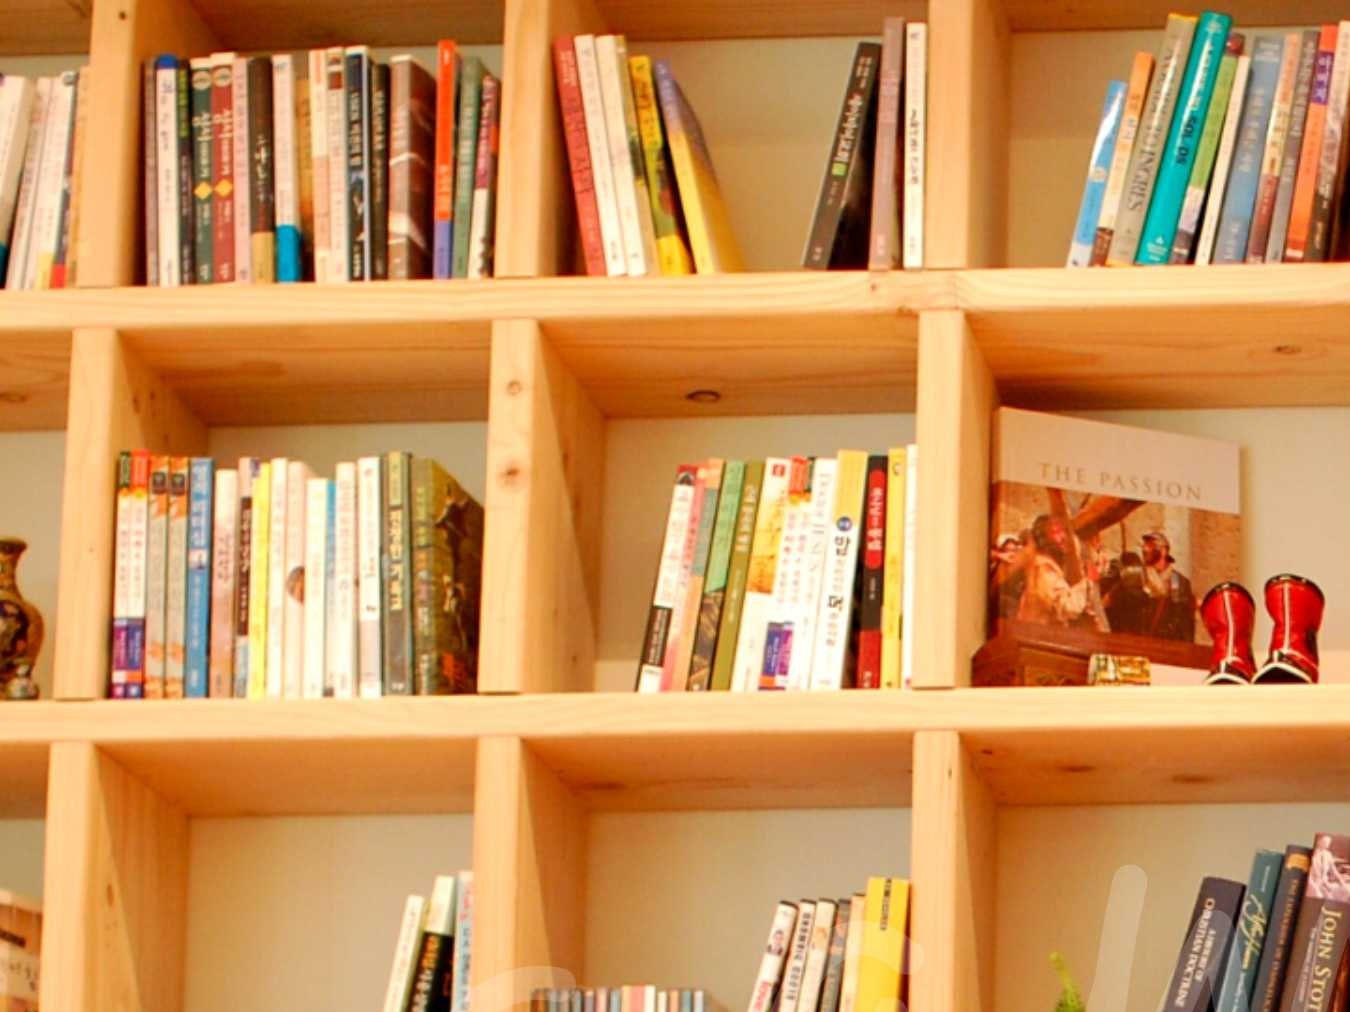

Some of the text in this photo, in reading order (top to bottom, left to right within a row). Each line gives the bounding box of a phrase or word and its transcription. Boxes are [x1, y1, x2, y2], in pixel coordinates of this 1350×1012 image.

[1040, 462, 1203, 501] THE PASSION
[1176, 898, 1213, 1007] CHRISTIAN DOCTRINE
[1320, 907, 1342, 959] JOHN
